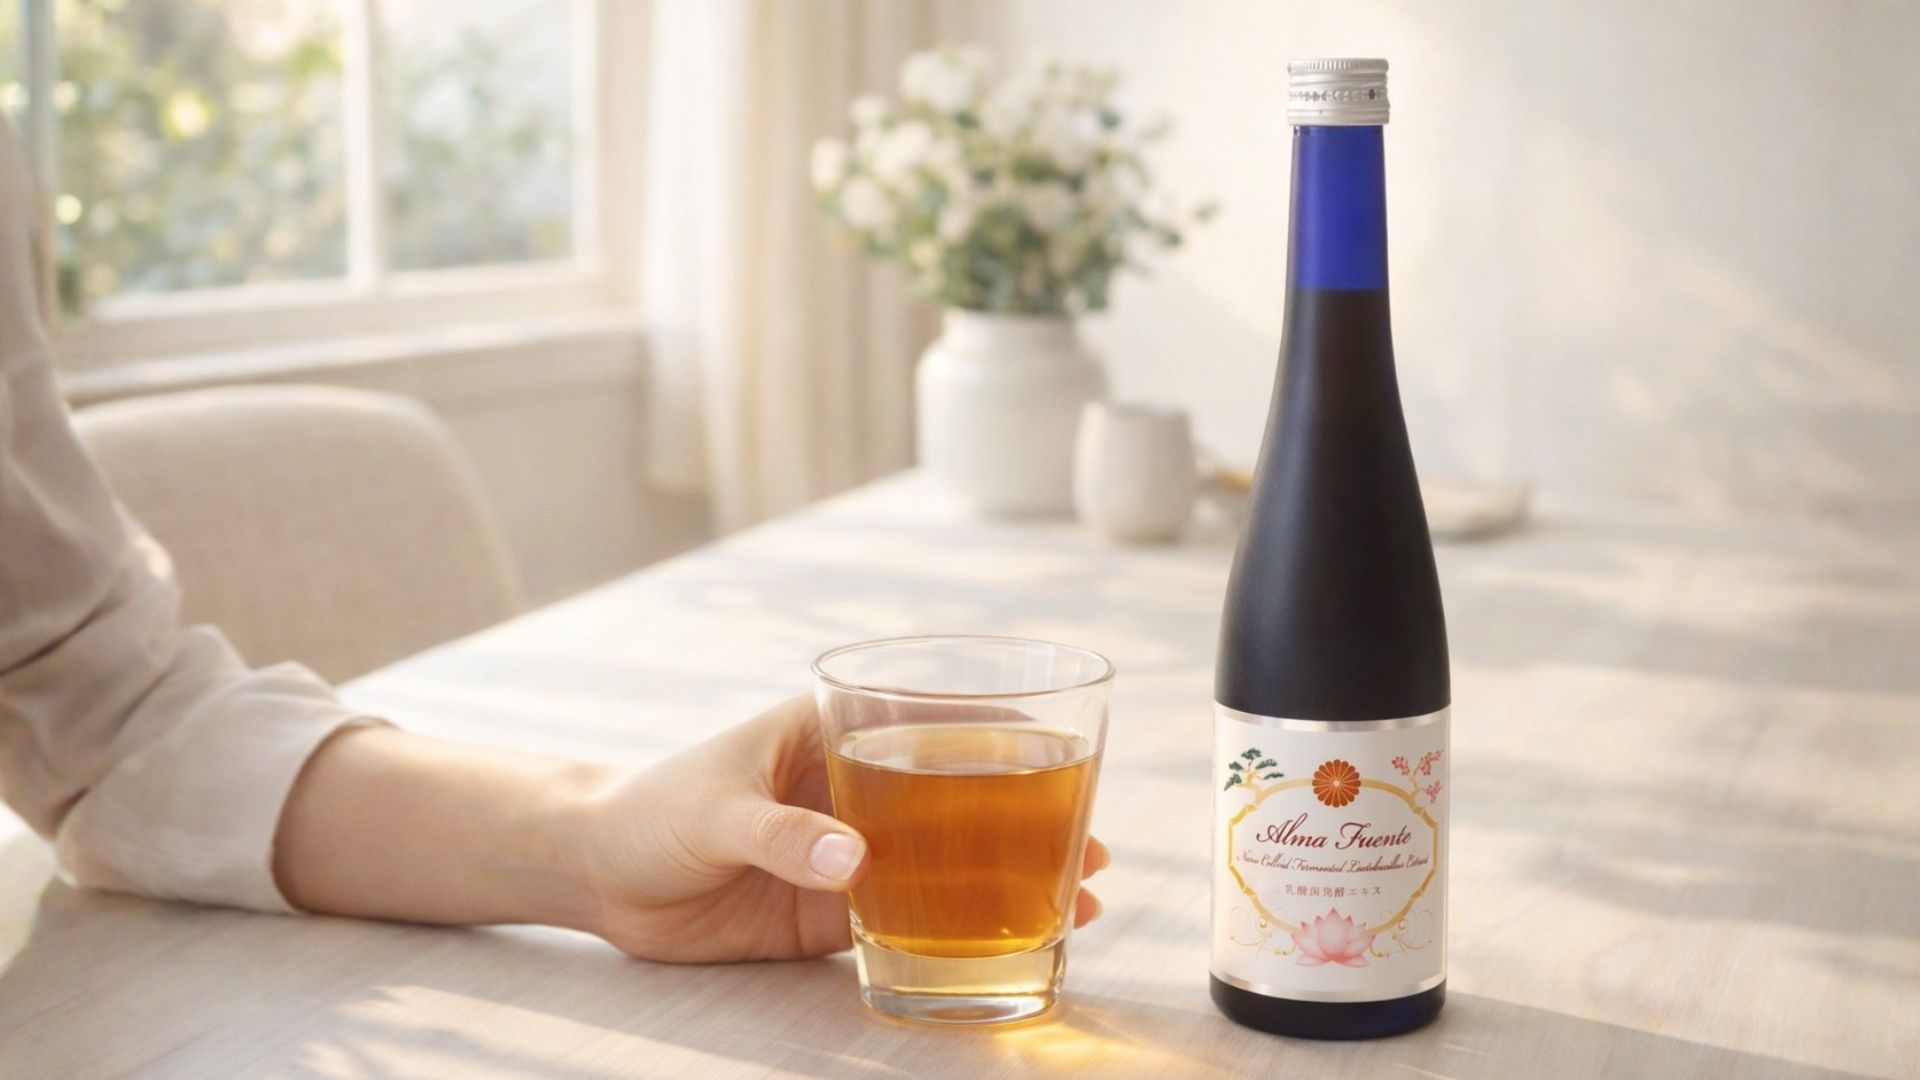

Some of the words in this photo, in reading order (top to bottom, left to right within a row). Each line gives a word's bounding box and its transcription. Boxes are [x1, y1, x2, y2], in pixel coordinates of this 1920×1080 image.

[1256, 812, 1328, 848] Alma
[1335, 822, 1412, 850] Fuente
[1284, 883, 1382, 898] 乳酸菌発酵エキス
